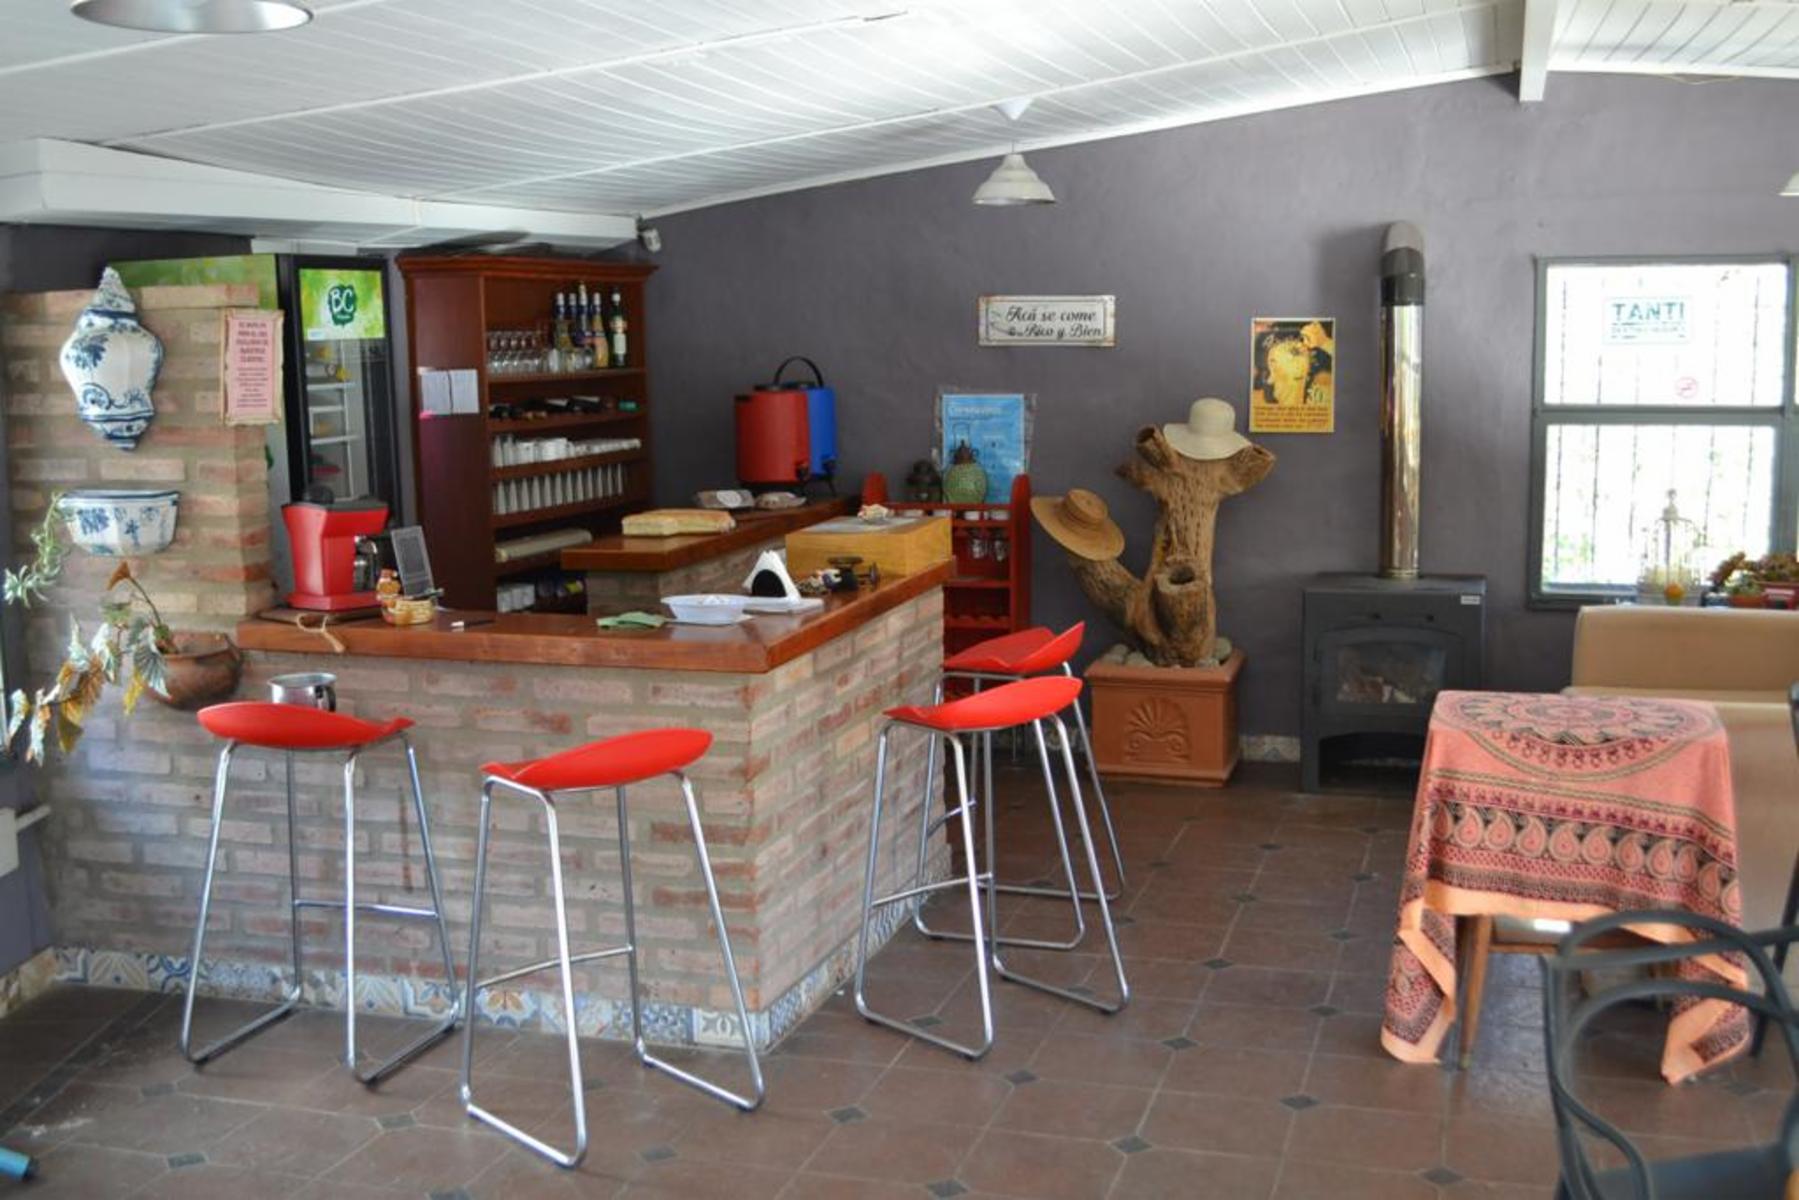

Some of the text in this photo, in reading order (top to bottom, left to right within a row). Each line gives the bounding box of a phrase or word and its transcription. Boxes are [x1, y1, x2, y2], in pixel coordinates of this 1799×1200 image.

[330, 288, 354, 312] BC
[1041, 310, 1056, 322] se
[1060, 310, 1097, 322] come
[1612, 301, 1685, 321] TANTI
[1056, 326, 1065, 339] y
[1070, 324, 1102, 338] Bien
